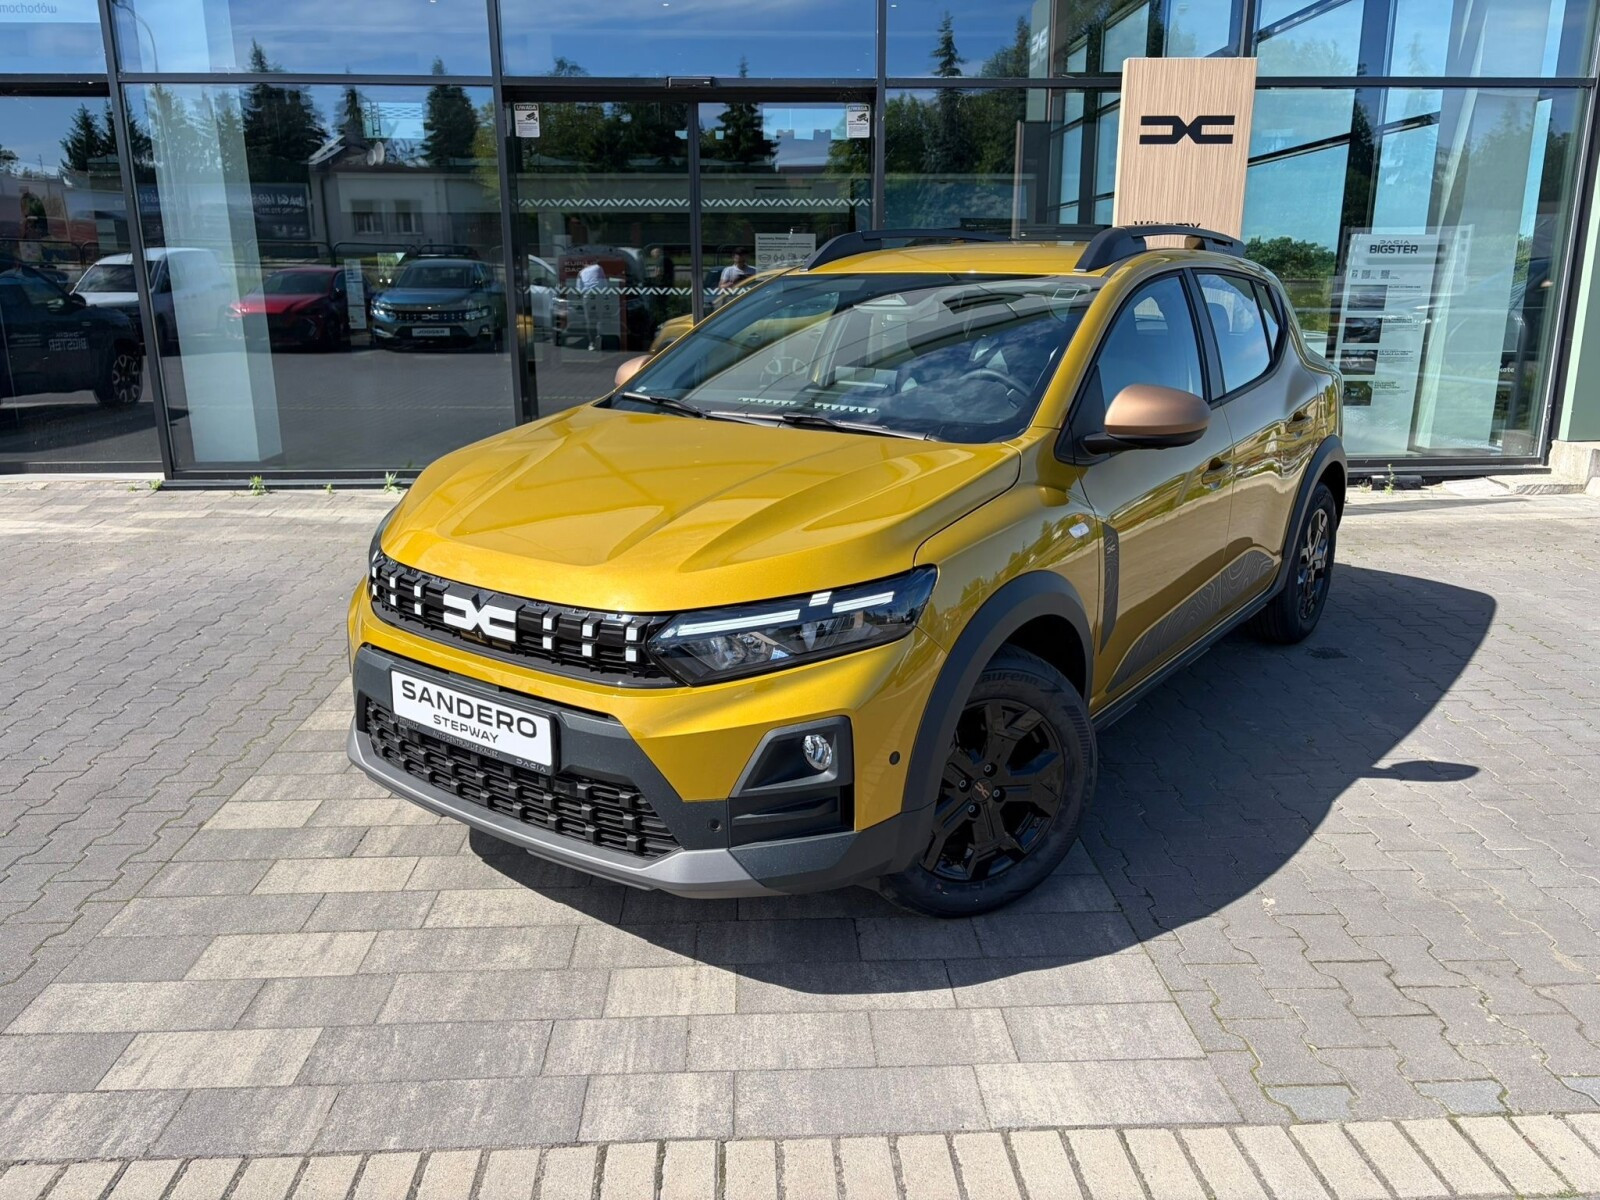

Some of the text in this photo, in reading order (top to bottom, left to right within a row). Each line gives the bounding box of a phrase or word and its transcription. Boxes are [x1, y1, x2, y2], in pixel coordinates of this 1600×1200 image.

[1369, 244, 1419, 254] BIGSTER
[402, 680, 537, 739] SANDERO
[433, 714, 499, 743] STEPWAY
[516, 758, 547, 773] DACIA
